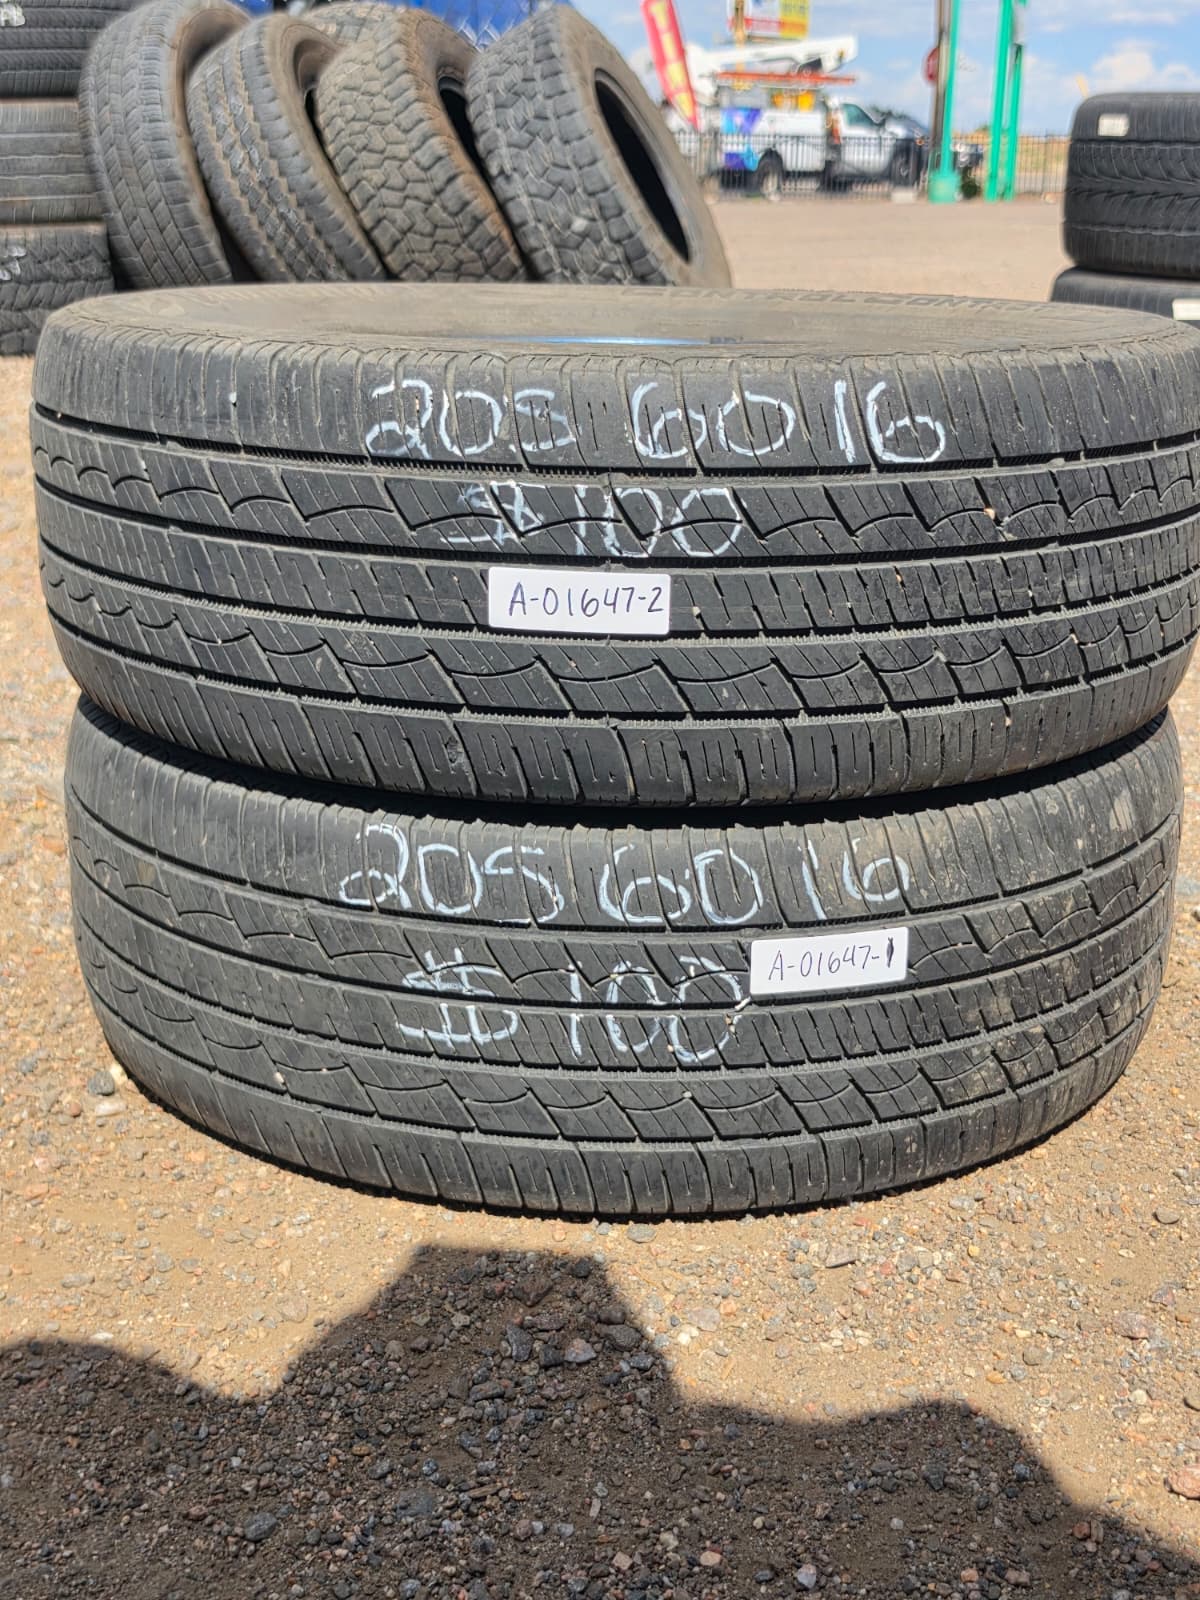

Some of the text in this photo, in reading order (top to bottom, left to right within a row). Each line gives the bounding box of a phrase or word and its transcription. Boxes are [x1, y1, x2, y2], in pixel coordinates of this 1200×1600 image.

[364, 378, 947, 463] 205 60 16
[508, 581, 664, 617] A-01647-2
[338, 824, 911, 925] 205 60 16
[768, 936, 895, 981] A-01647-1
